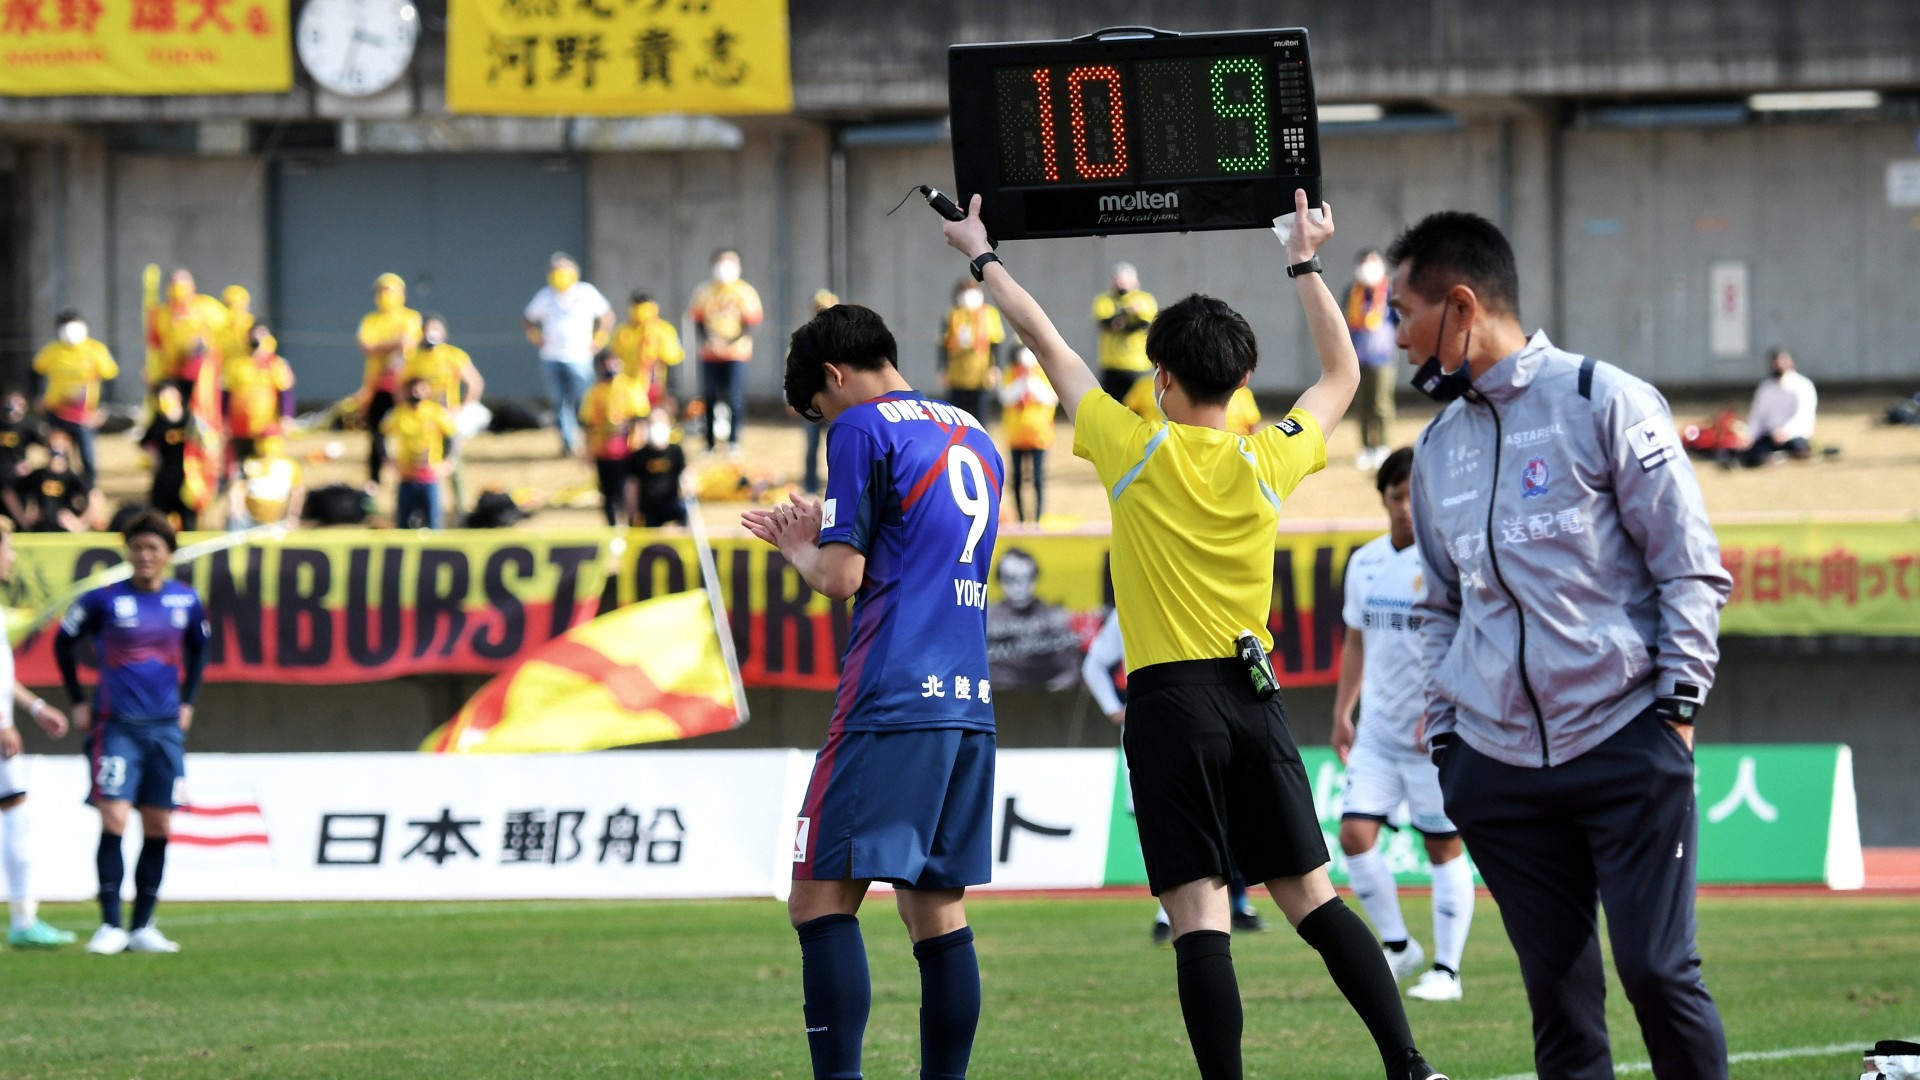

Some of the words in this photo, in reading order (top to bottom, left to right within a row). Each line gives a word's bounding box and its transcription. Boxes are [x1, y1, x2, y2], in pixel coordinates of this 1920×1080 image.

[486, 27, 752, 88] 河野貴志
[1033, 66, 1128, 181] 10
[1210, 58, 1270, 172] 9
[1098, 213, 1113, 224] For
[1115, 213, 1129, 222] the
[1131, 211, 1152, 221] real
[1152, 213, 1179, 223] game
[1099, 190, 1178, 211] molten
[877, 400, 930, 423] ONE
[920, 400, 989, 436] TOYA
[1505, 423, 1564, 446] ASTAREAL
[948, 444, 990, 564] 9
[1501, 507, 1584, 544] 送配電
[921, 675, 991, 704] 北陸電
[315, 806, 688, 867] 日本郵船
